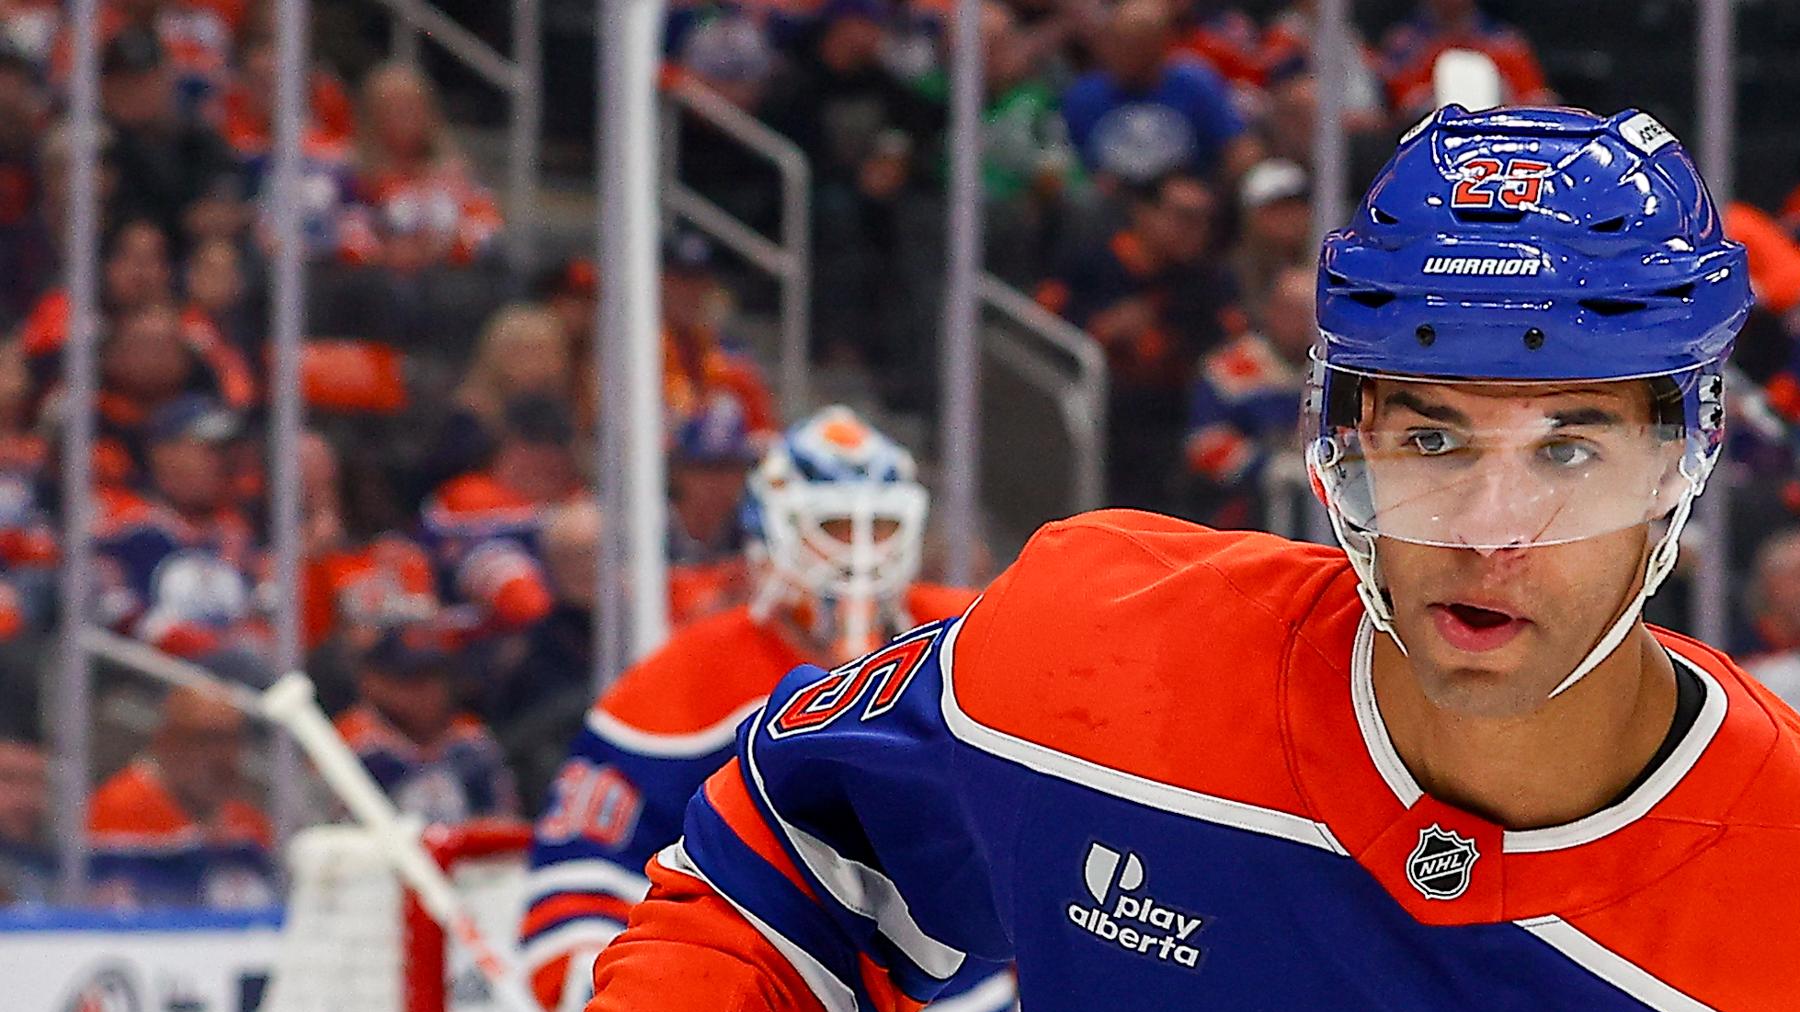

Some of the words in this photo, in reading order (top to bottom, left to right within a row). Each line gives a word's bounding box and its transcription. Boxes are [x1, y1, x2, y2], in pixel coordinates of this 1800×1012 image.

[1450, 158, 1552, 208] 25
[1423, 257, 1541, 275] WARRIOR
[1419, 853, 1464, 877] NHL
[1068, 903, 1200, 968] alberta
[1113, 895, 1202, 941] play
